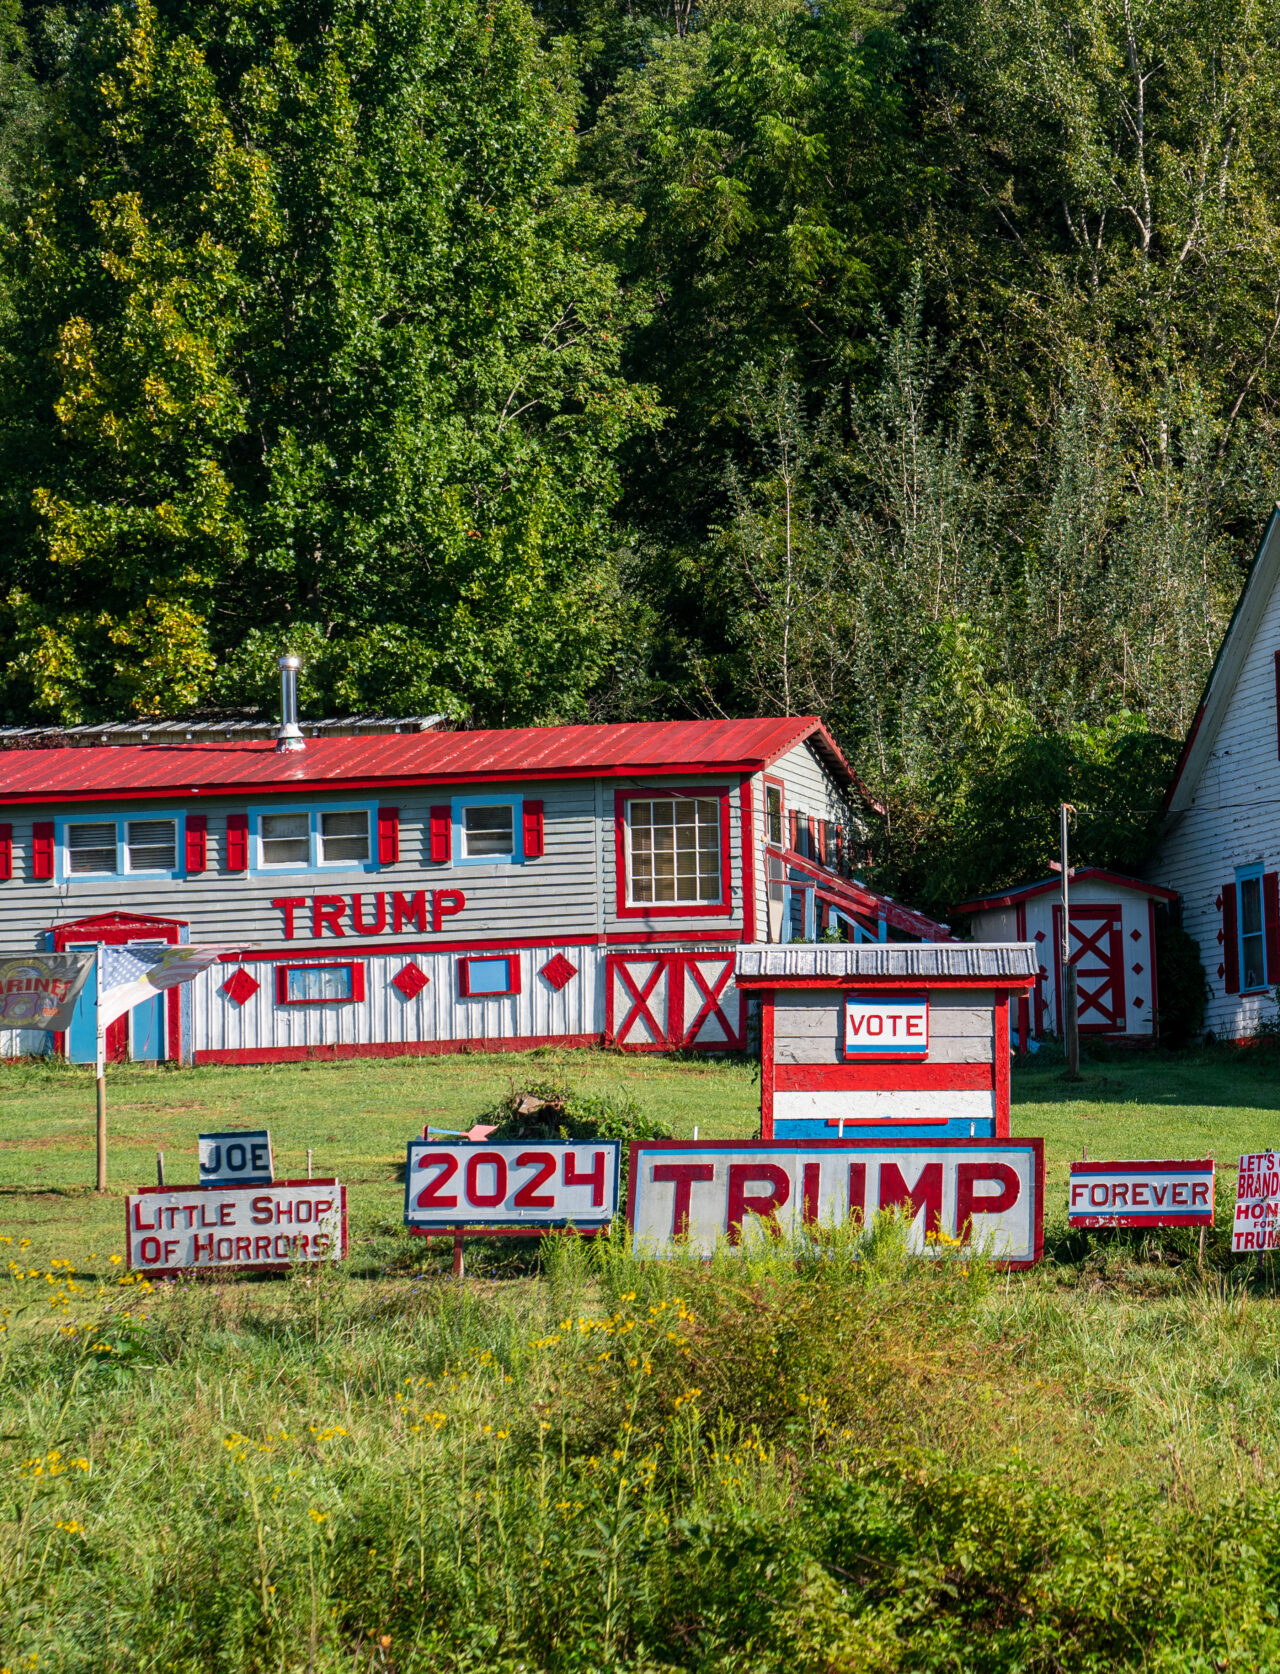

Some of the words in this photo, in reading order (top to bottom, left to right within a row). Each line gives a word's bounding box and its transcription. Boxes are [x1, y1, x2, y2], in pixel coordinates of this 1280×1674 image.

[272, 888, 467, 941] TRUMP
[848, 1014, 924, 1038] VOTE
[200, 1143, 269, 1173] JOE
[1240, 1153, 1275, 1173] LET'S
[417, 1151, 605, 1208] 2024
[652, 1162, 1021, 1247] TRUMP
[1071, 1182, 1209, 1207] FOREVER
[134, 1202, 236, 1231] LITTLE
[252, 1196, 332, 1224] SHOP
[1253, 1220, 1275, 1229] FOR
[193, 1233, 330, 1262] HORRORS
